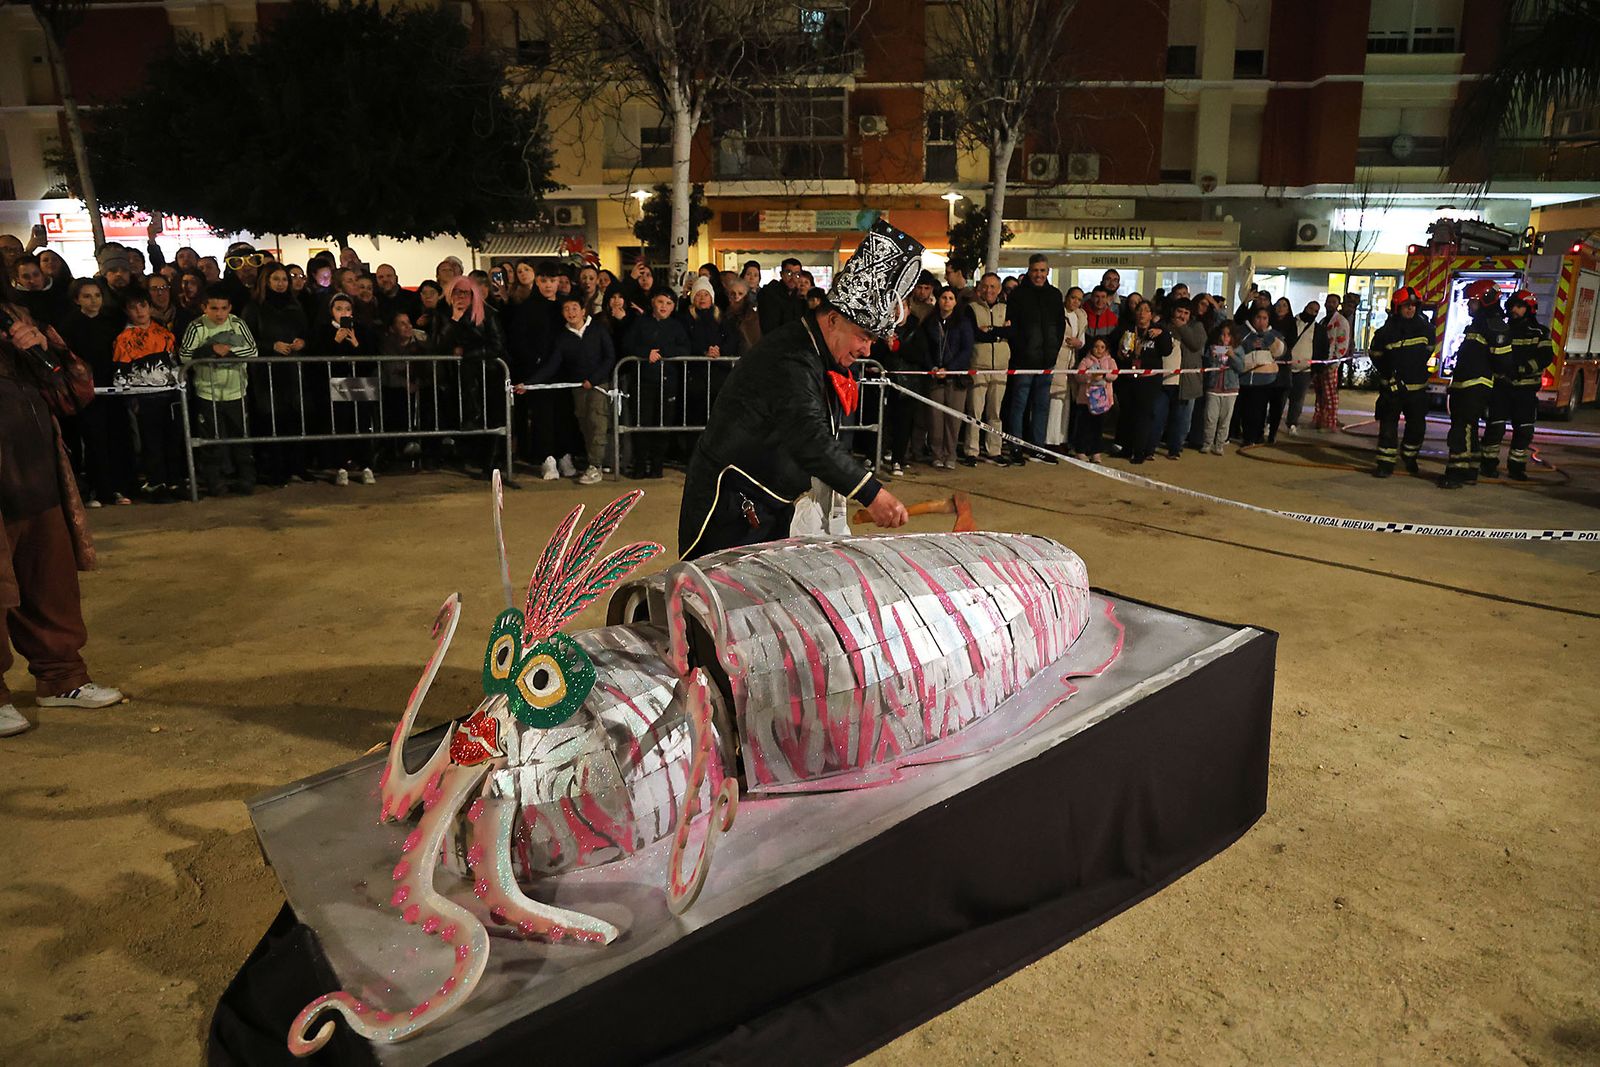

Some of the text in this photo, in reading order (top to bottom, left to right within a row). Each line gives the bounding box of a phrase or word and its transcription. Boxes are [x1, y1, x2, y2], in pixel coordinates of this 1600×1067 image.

[1129, 226, 1147, 241] ELY
[1313, 516, 1340, 527] LOCAL
[1342, 519, 1374, 530] HUELVA
[1415, 527, 1527, 539] POLICIA LOCAL HUELVA
[1578, 532, 1599, 541] POL
